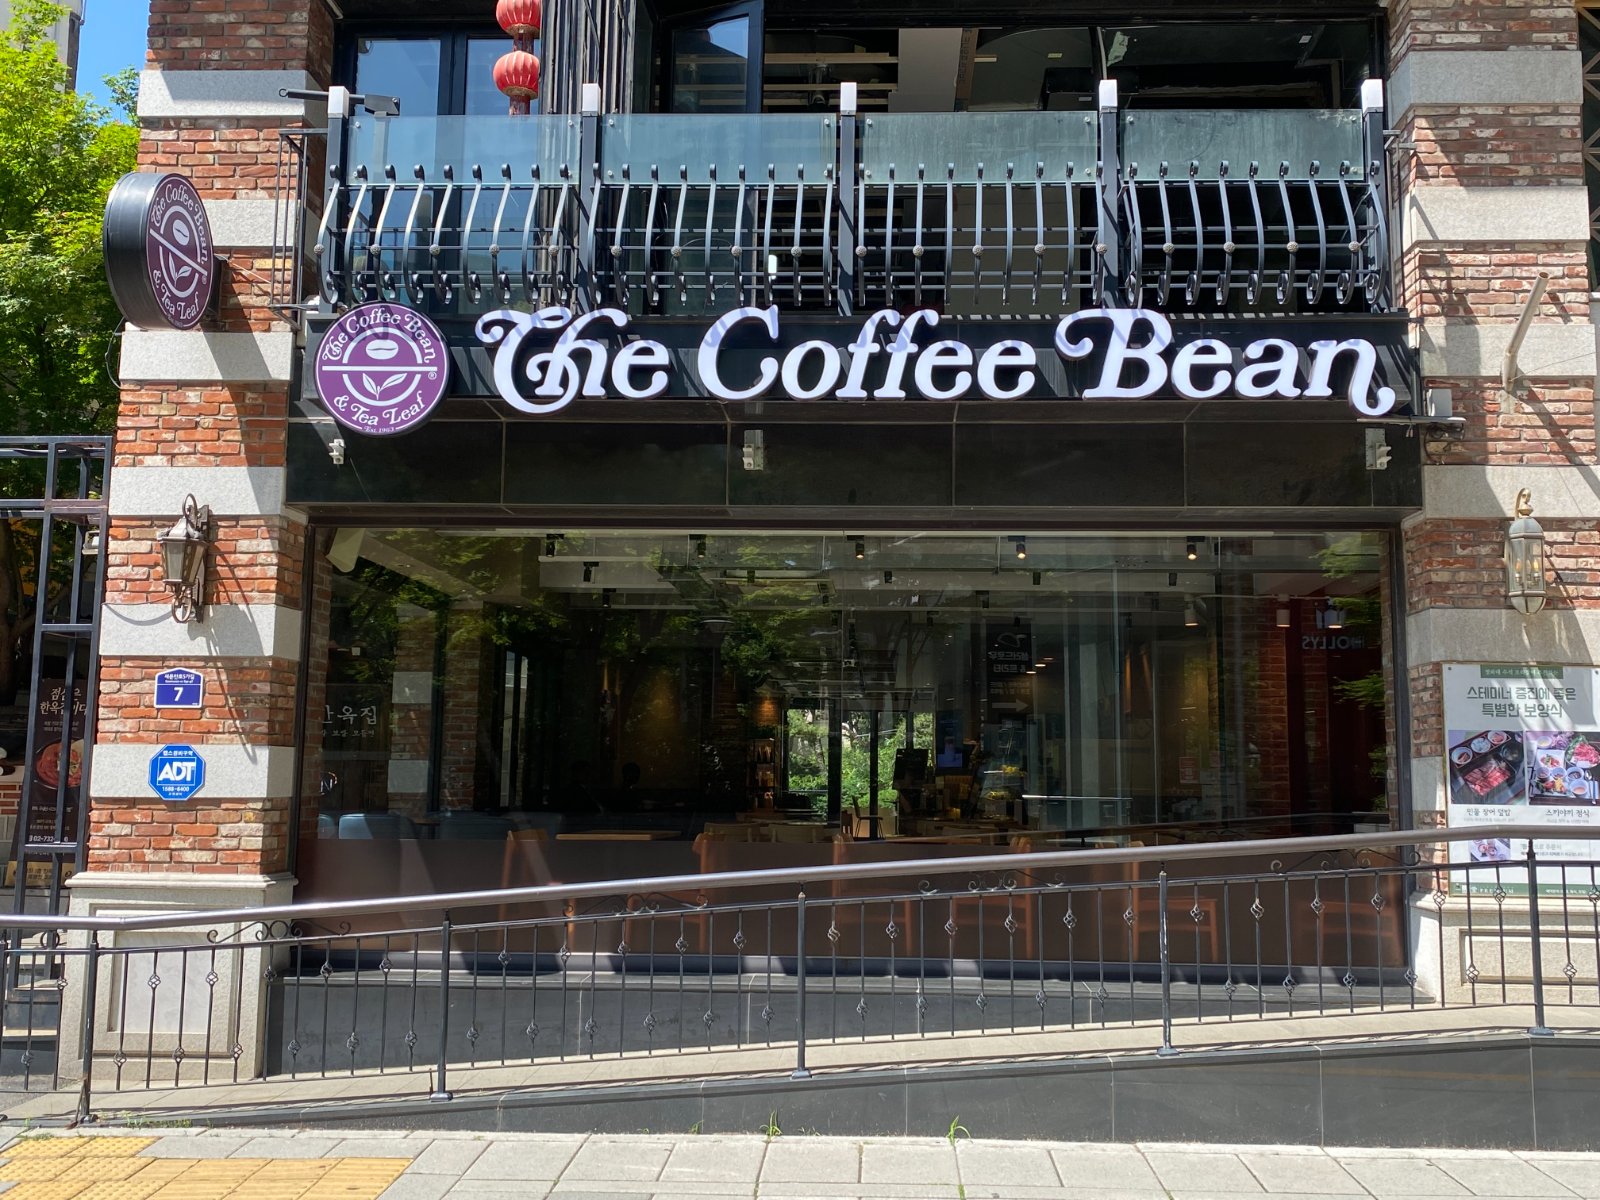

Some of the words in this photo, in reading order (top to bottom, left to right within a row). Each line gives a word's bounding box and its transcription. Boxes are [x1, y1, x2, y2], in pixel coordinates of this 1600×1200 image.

[150, 195, 166, 227] The
[165, 184, 194, 210] Coffee
[193, 204, 208, 265] Bean
[152, 269, 162, 288] &
[161, 283, 176, 316] Tea
[176, 292, 200, 320] Leaf
[322, 332, 349, 360] The
[346, 307, 401, 334] Coffee
[403, 313, 436, 364] Bean
[474, 305, 672, 416] The
[697, 304, 1038, 401] Coffee
[1054, 306, 1397, 417] Bean
[333, 395, 350, 411] &
[350, 403, 379, 426] Tea
[382, 390, 425, 424] Leaf
[173, 686, 184, 702] 7
[1466, 686, 1512, 700] 스테미너
[1515, 686, 1550, 700] 증진에
[1481, 702, 1520, 718] 특별한
[1524, 703, 1563, 718] 보양식
[158, 761, 196, 782] ADT
